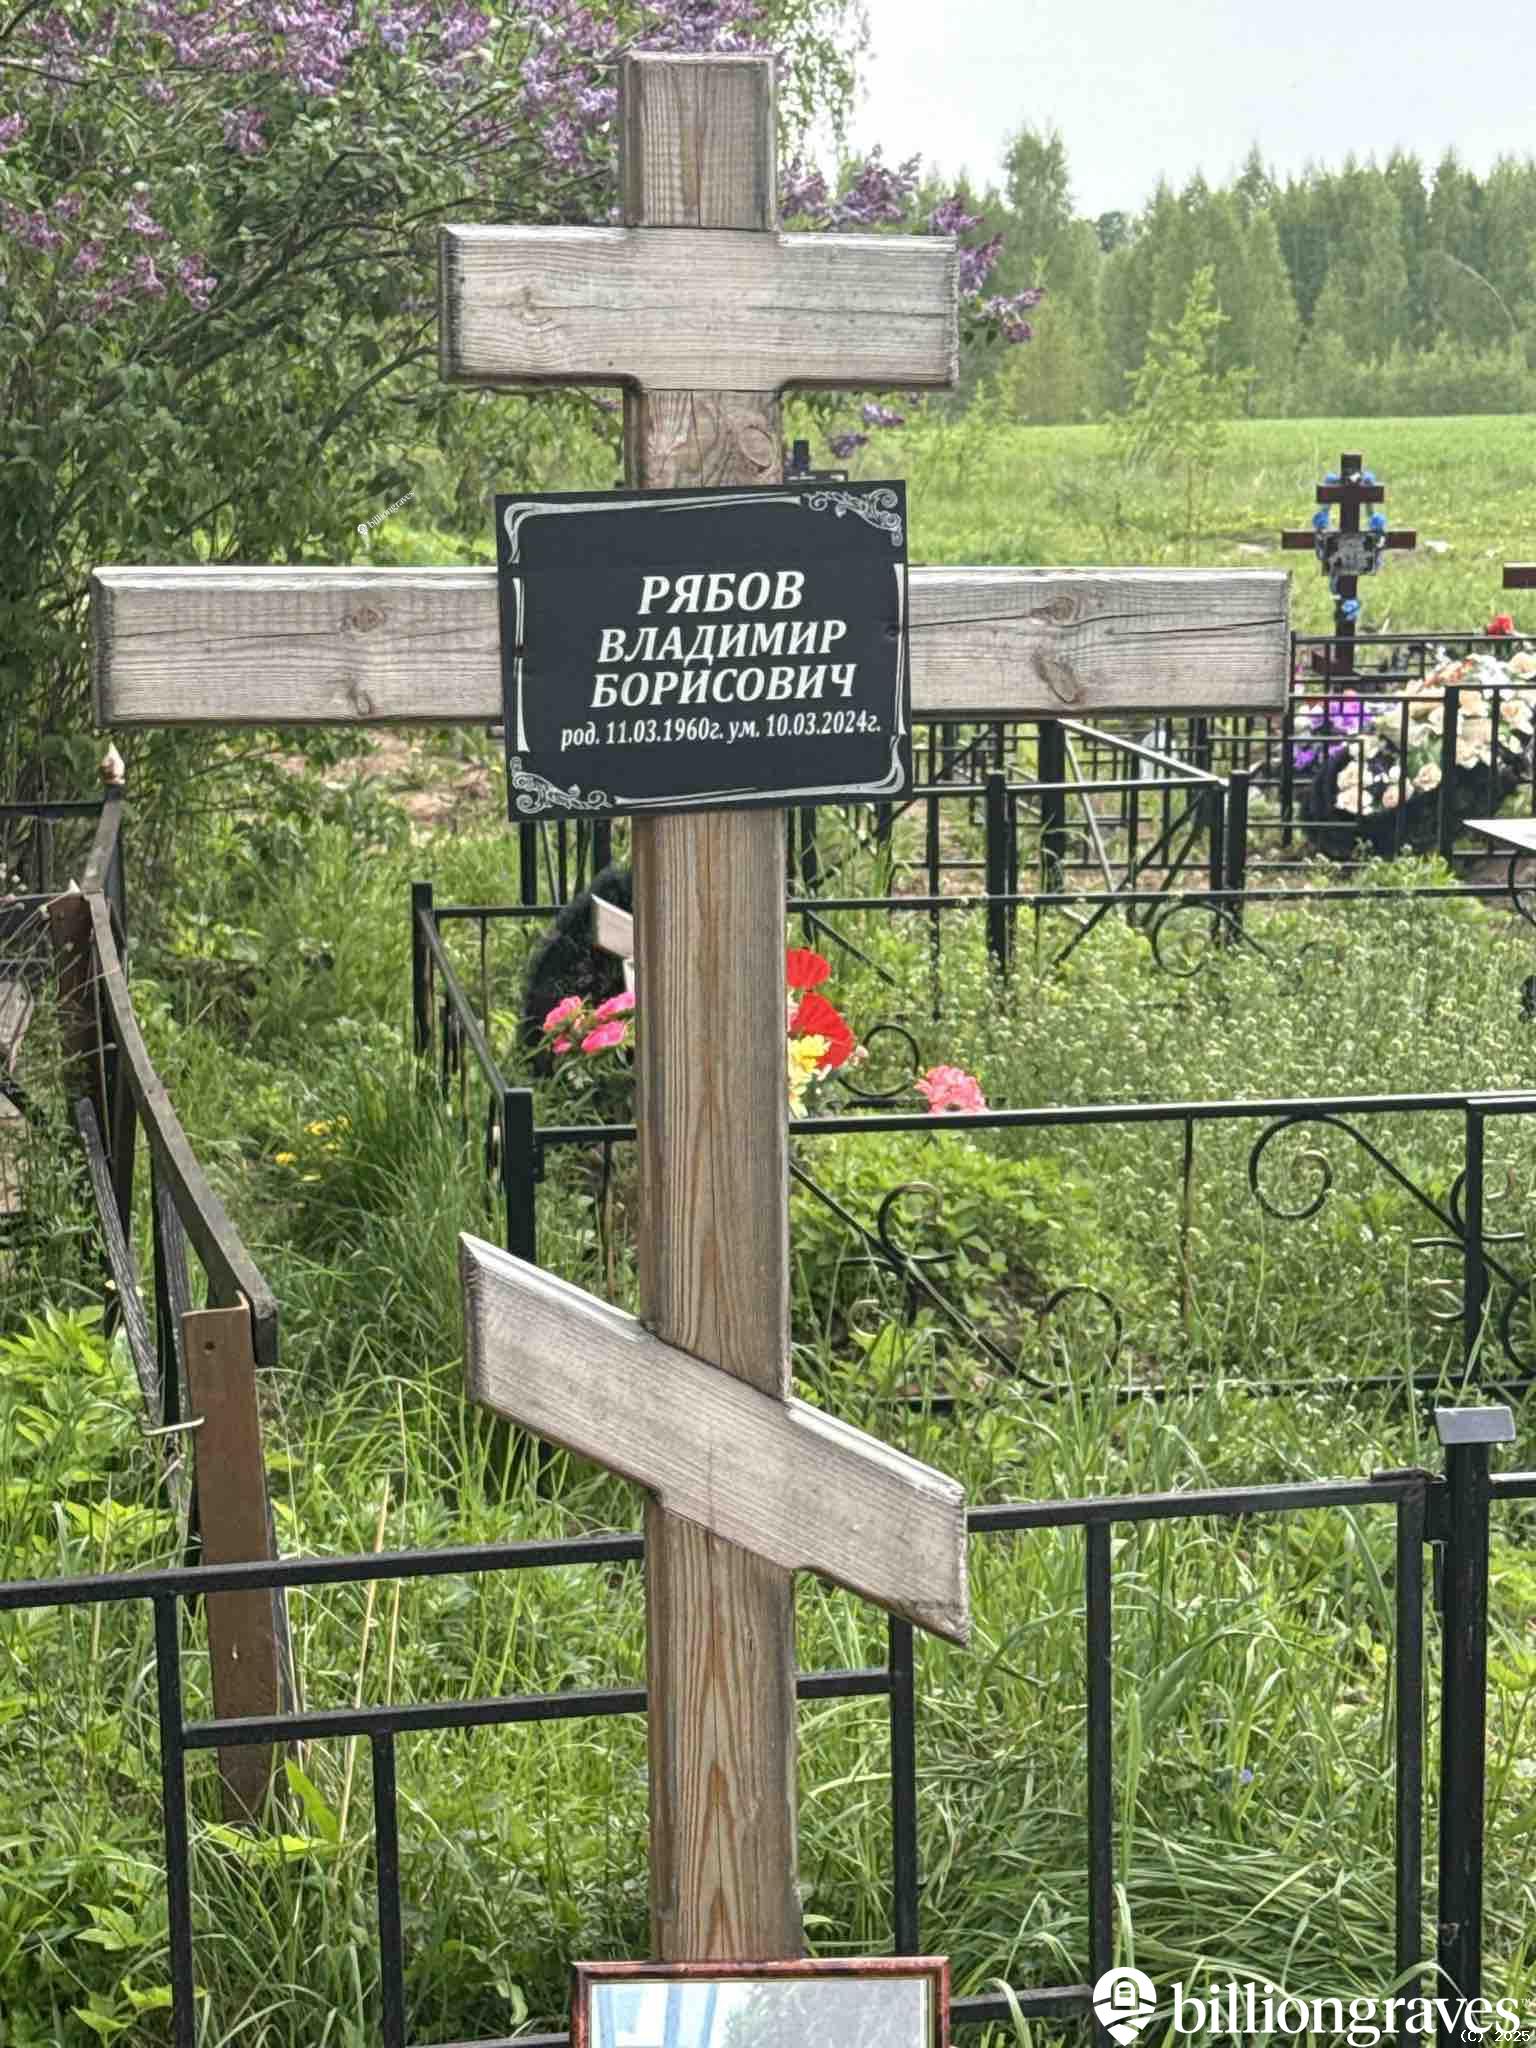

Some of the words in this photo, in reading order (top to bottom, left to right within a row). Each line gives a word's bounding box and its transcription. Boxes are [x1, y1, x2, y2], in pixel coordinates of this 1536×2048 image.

[637, 571, 805, 615] РЯБОВ
[597, 619, 847, 668] ВЛАДИМИР
[590, 664, 857, 708] БОРИСОВИЧ
[561, 721, 600, 752] род.
[606, 717, 724, 745] 11.03.1960г.
[727, 720, 761, 745] ум.
[767, 710, 881, 738] 10.03.2024г.
